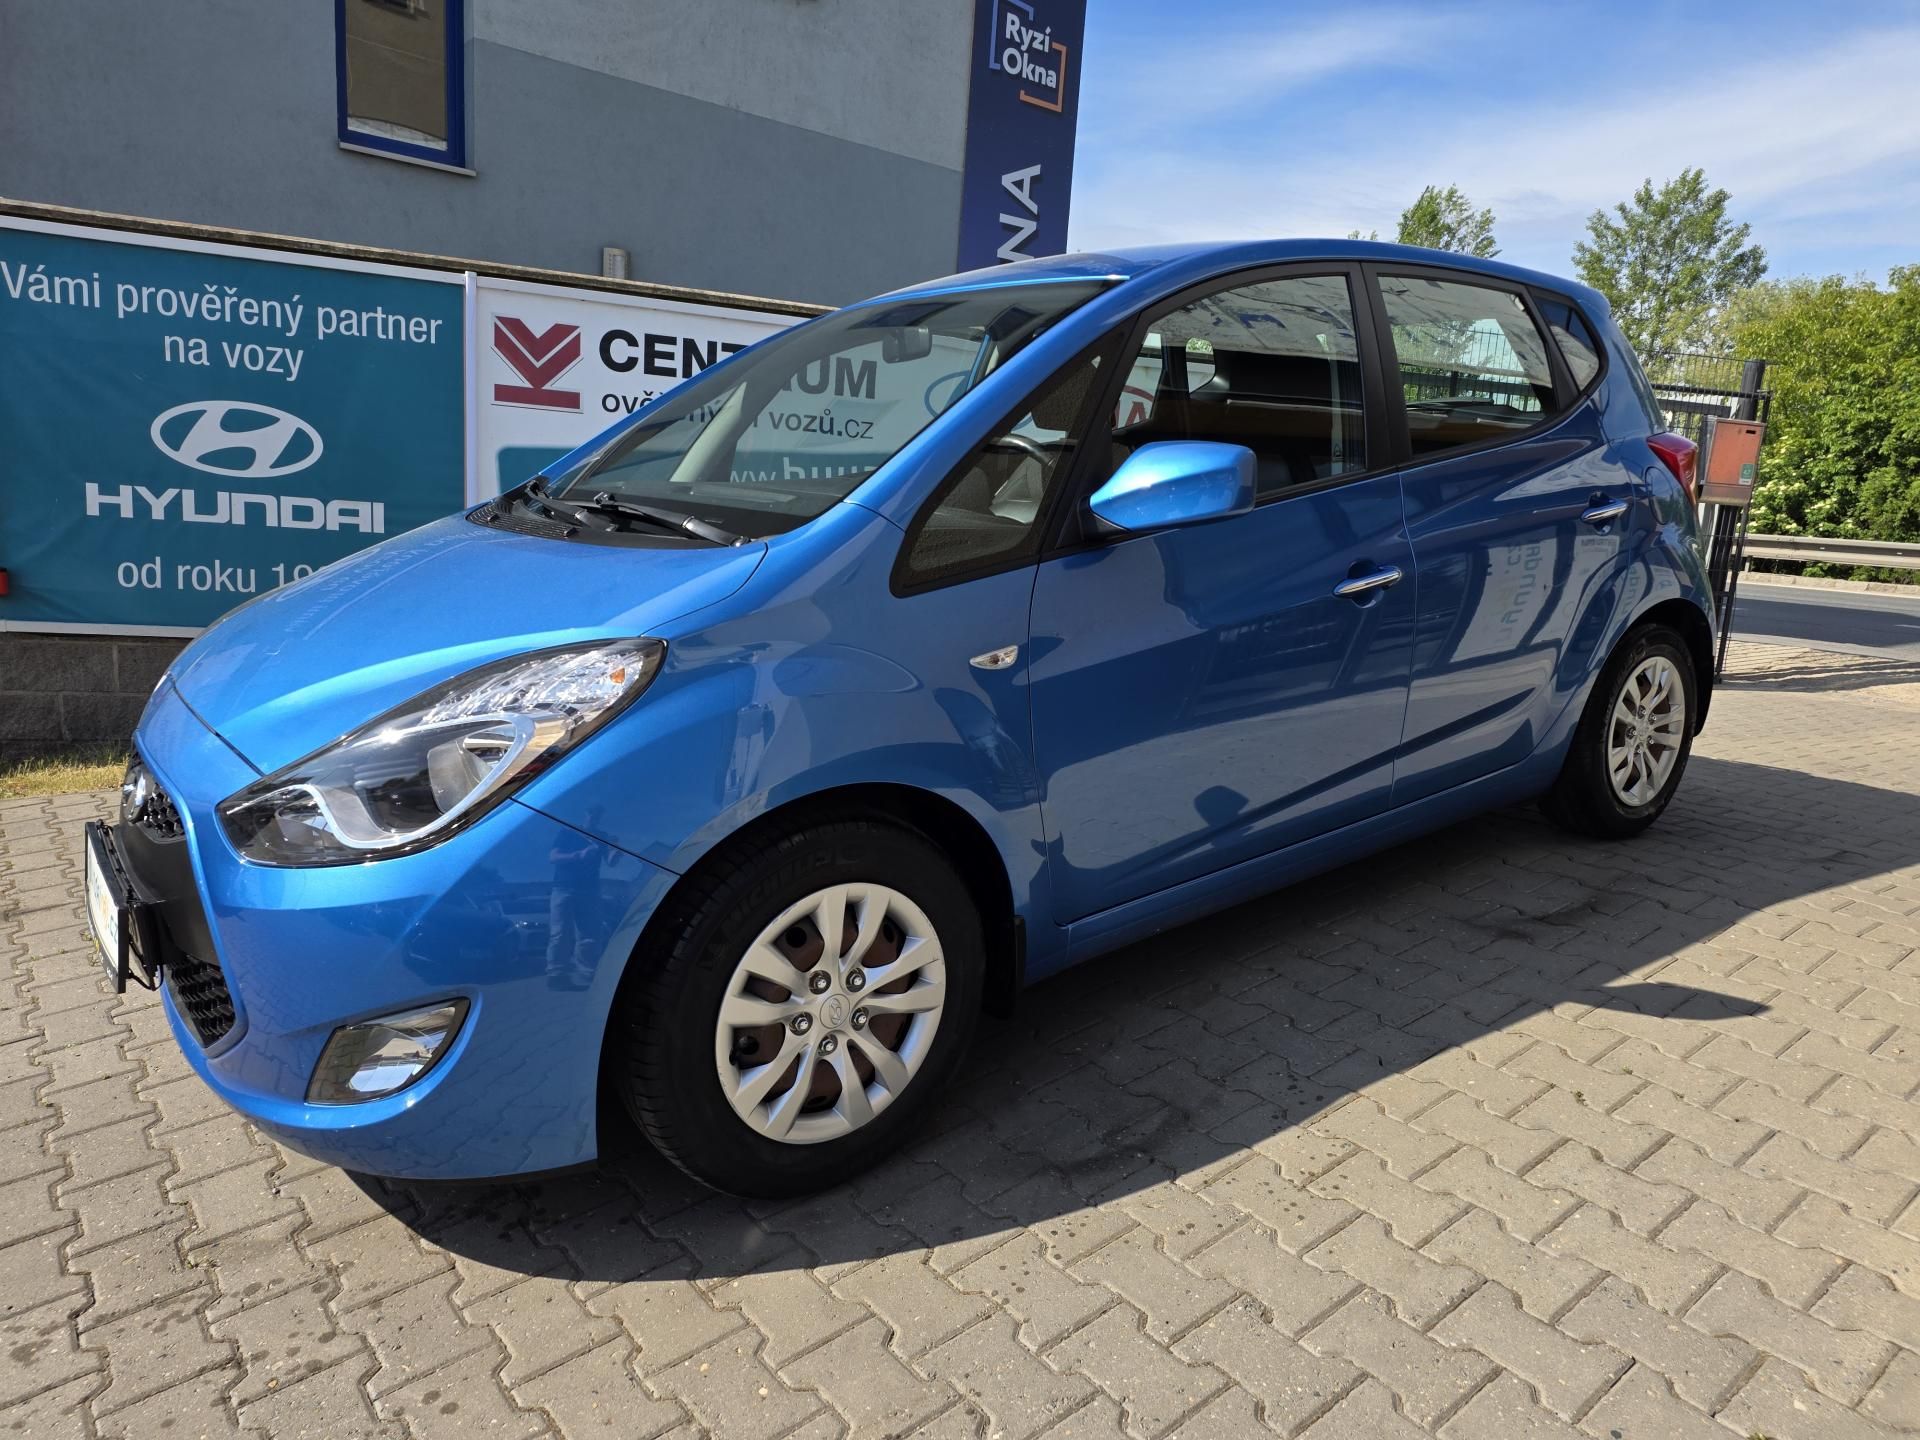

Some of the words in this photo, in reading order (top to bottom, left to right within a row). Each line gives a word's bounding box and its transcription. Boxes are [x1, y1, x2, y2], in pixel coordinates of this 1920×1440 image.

[1005, 12, 1051, 53] Ryzí
[1002, 47, 1057, 89] Okna
[0, 261, 100, 308] Vámi
[117, 282, 304, 337] prověřený
[317, 305, 443, 344] partner
[164, 334, 210, 366] na
[222, 341, 304, 382] vozy
[599, 329, 878, 400] CENUM
[768, 408, 874, 440] vozů.cz
[85, 482, 385, 534] HYUNDAI
[117, 556, 162, 589] od
[177, 561, 256, 593] roku
